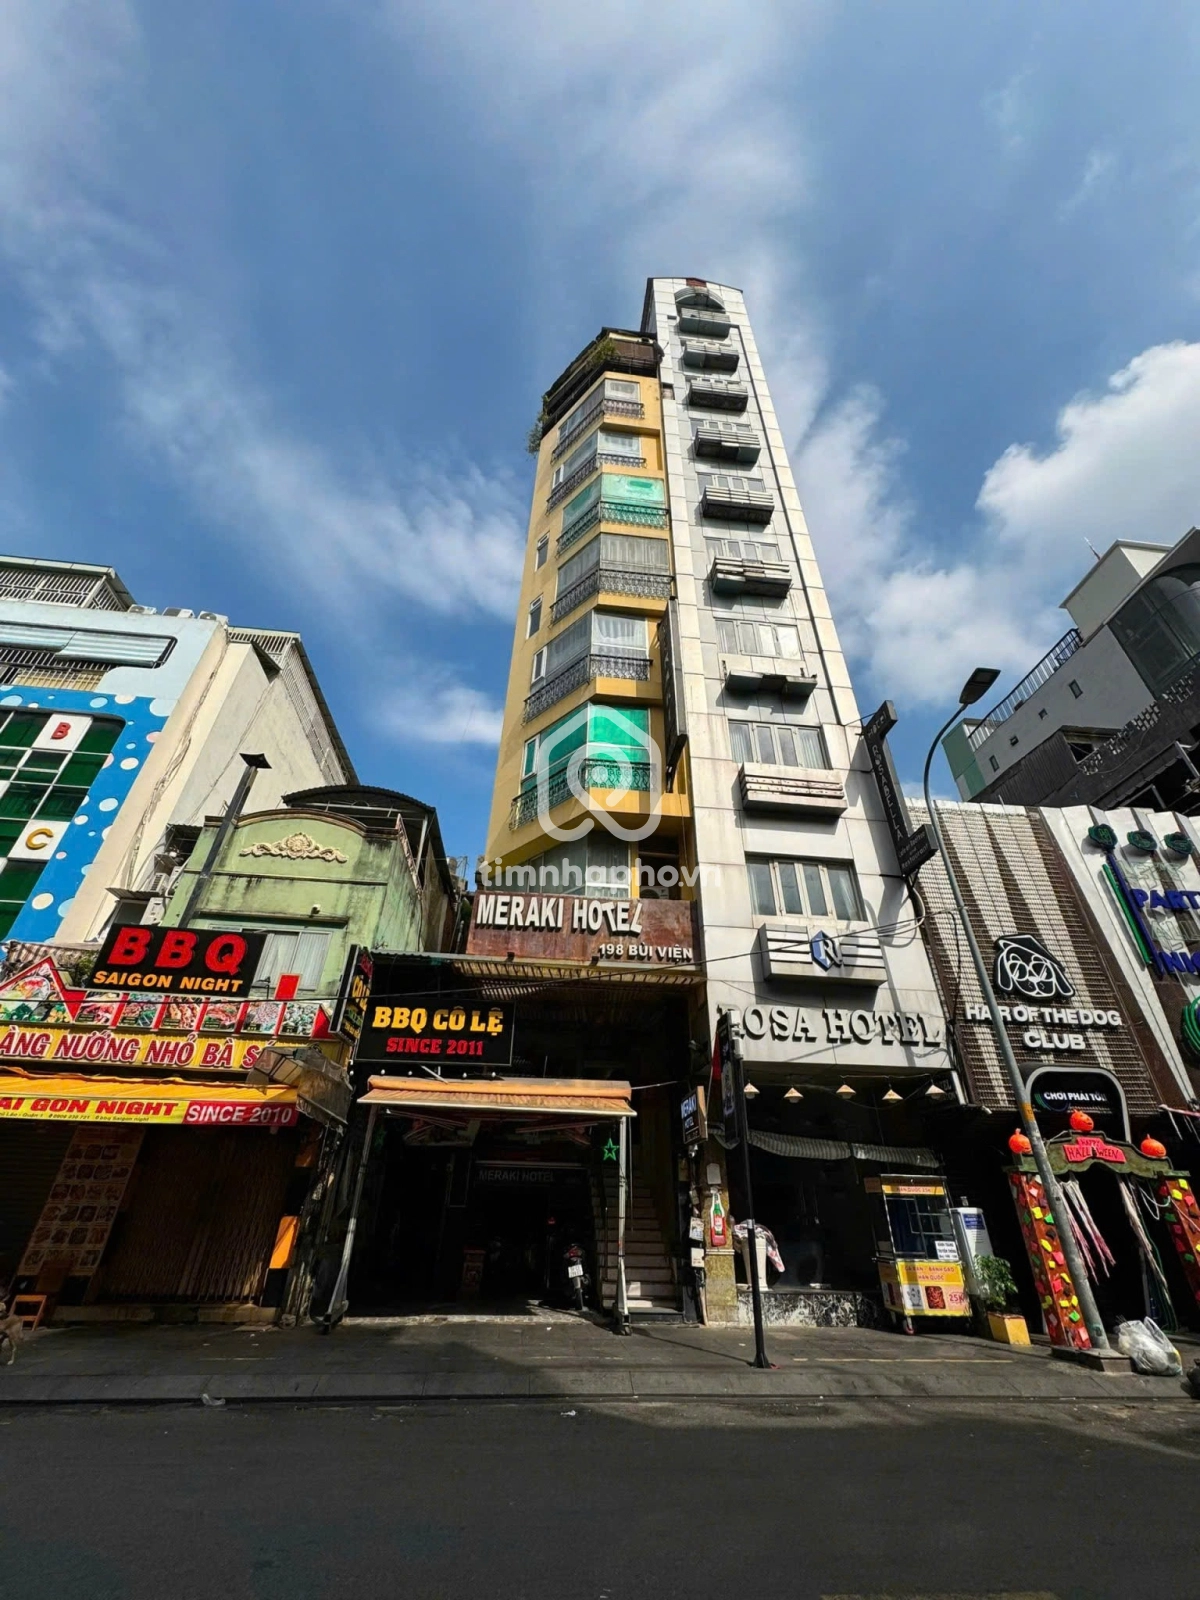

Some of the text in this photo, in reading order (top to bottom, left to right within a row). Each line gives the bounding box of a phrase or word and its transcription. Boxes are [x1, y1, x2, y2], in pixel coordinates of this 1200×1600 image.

[51, 721, 71, 740] B
[26, 828, 54, 850] C
[476, 894, 644, 934] MERAKI HOTEL
[107, 927, 247, 975] BBQ
[599, 942, 694, 963] 198 BÙI VIỆN
[93, 971, 243, 992] SAIGON NIGHT
[372, 1006, 428, 1034] BBQ
[433, 1005, 467, 1031] CÔ
[470, 1007, 504, 1036] LỆ
[965, 1003, 1122, 1026] HAR OF THE DOG
[822, 1008, 941, 1046] HOTEL
[54, 1031, 141, 1064] NƯỚNG
[142, 1032, 196, 1065] NHỎ
[200, 1038, 235, 1067] BÀ
[386, 1037, 485, 1056] SINCE 2011
[1023, 1031, 1086, 1049] CLUB
[30, 1098, 90, 1113] GON
[95, 1100, 179, 1116] NIGHT
[186, 1104, 246, 1122] SINCE
[249, 1106, 292, 1123] 2010
[1067, 1146, 1119, 1160] HALLWEEN
[478, 1169, 520, 1182] MERAKI
[522, 1170, 554, 1183] HOTEL
